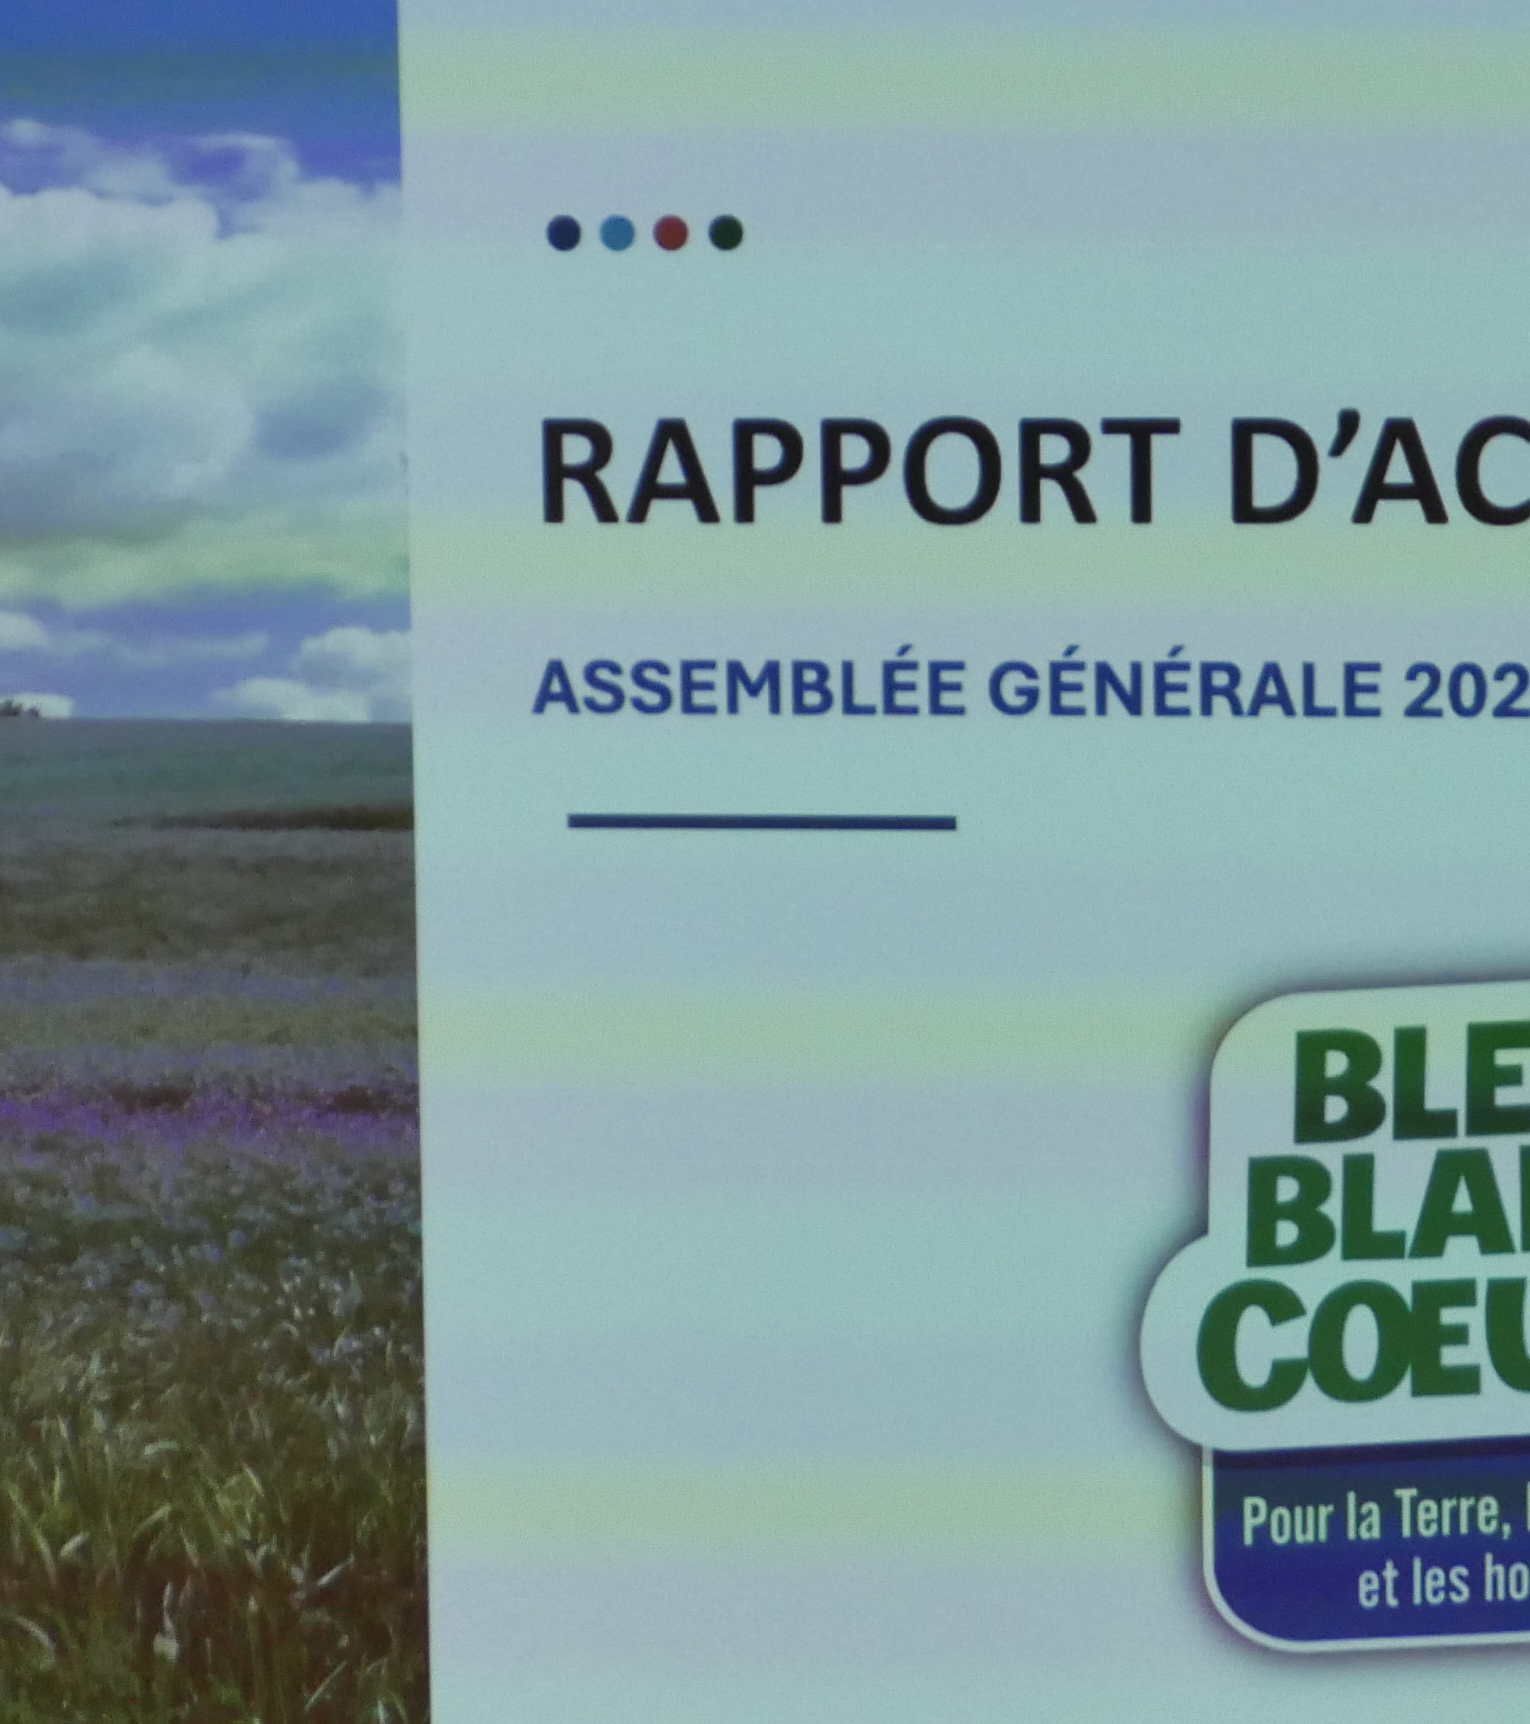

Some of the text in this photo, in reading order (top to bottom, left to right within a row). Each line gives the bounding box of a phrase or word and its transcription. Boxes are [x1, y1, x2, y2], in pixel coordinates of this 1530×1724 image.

[538, 414, 1182, 527] RAPPORT
[533, 645, 967, 718] ASSEMBLÉE
[987, 645, 1383, 719] GÉNÉRALE
[1242, 1497, 1336, 1546] Pour
[1347, 1492, 1383, 1540] la
[1395, 1486, 1512, 1540] Terre,
[1358, 1564, 1400, 1609] et
[1412, 1556, 1470, 1606] les
